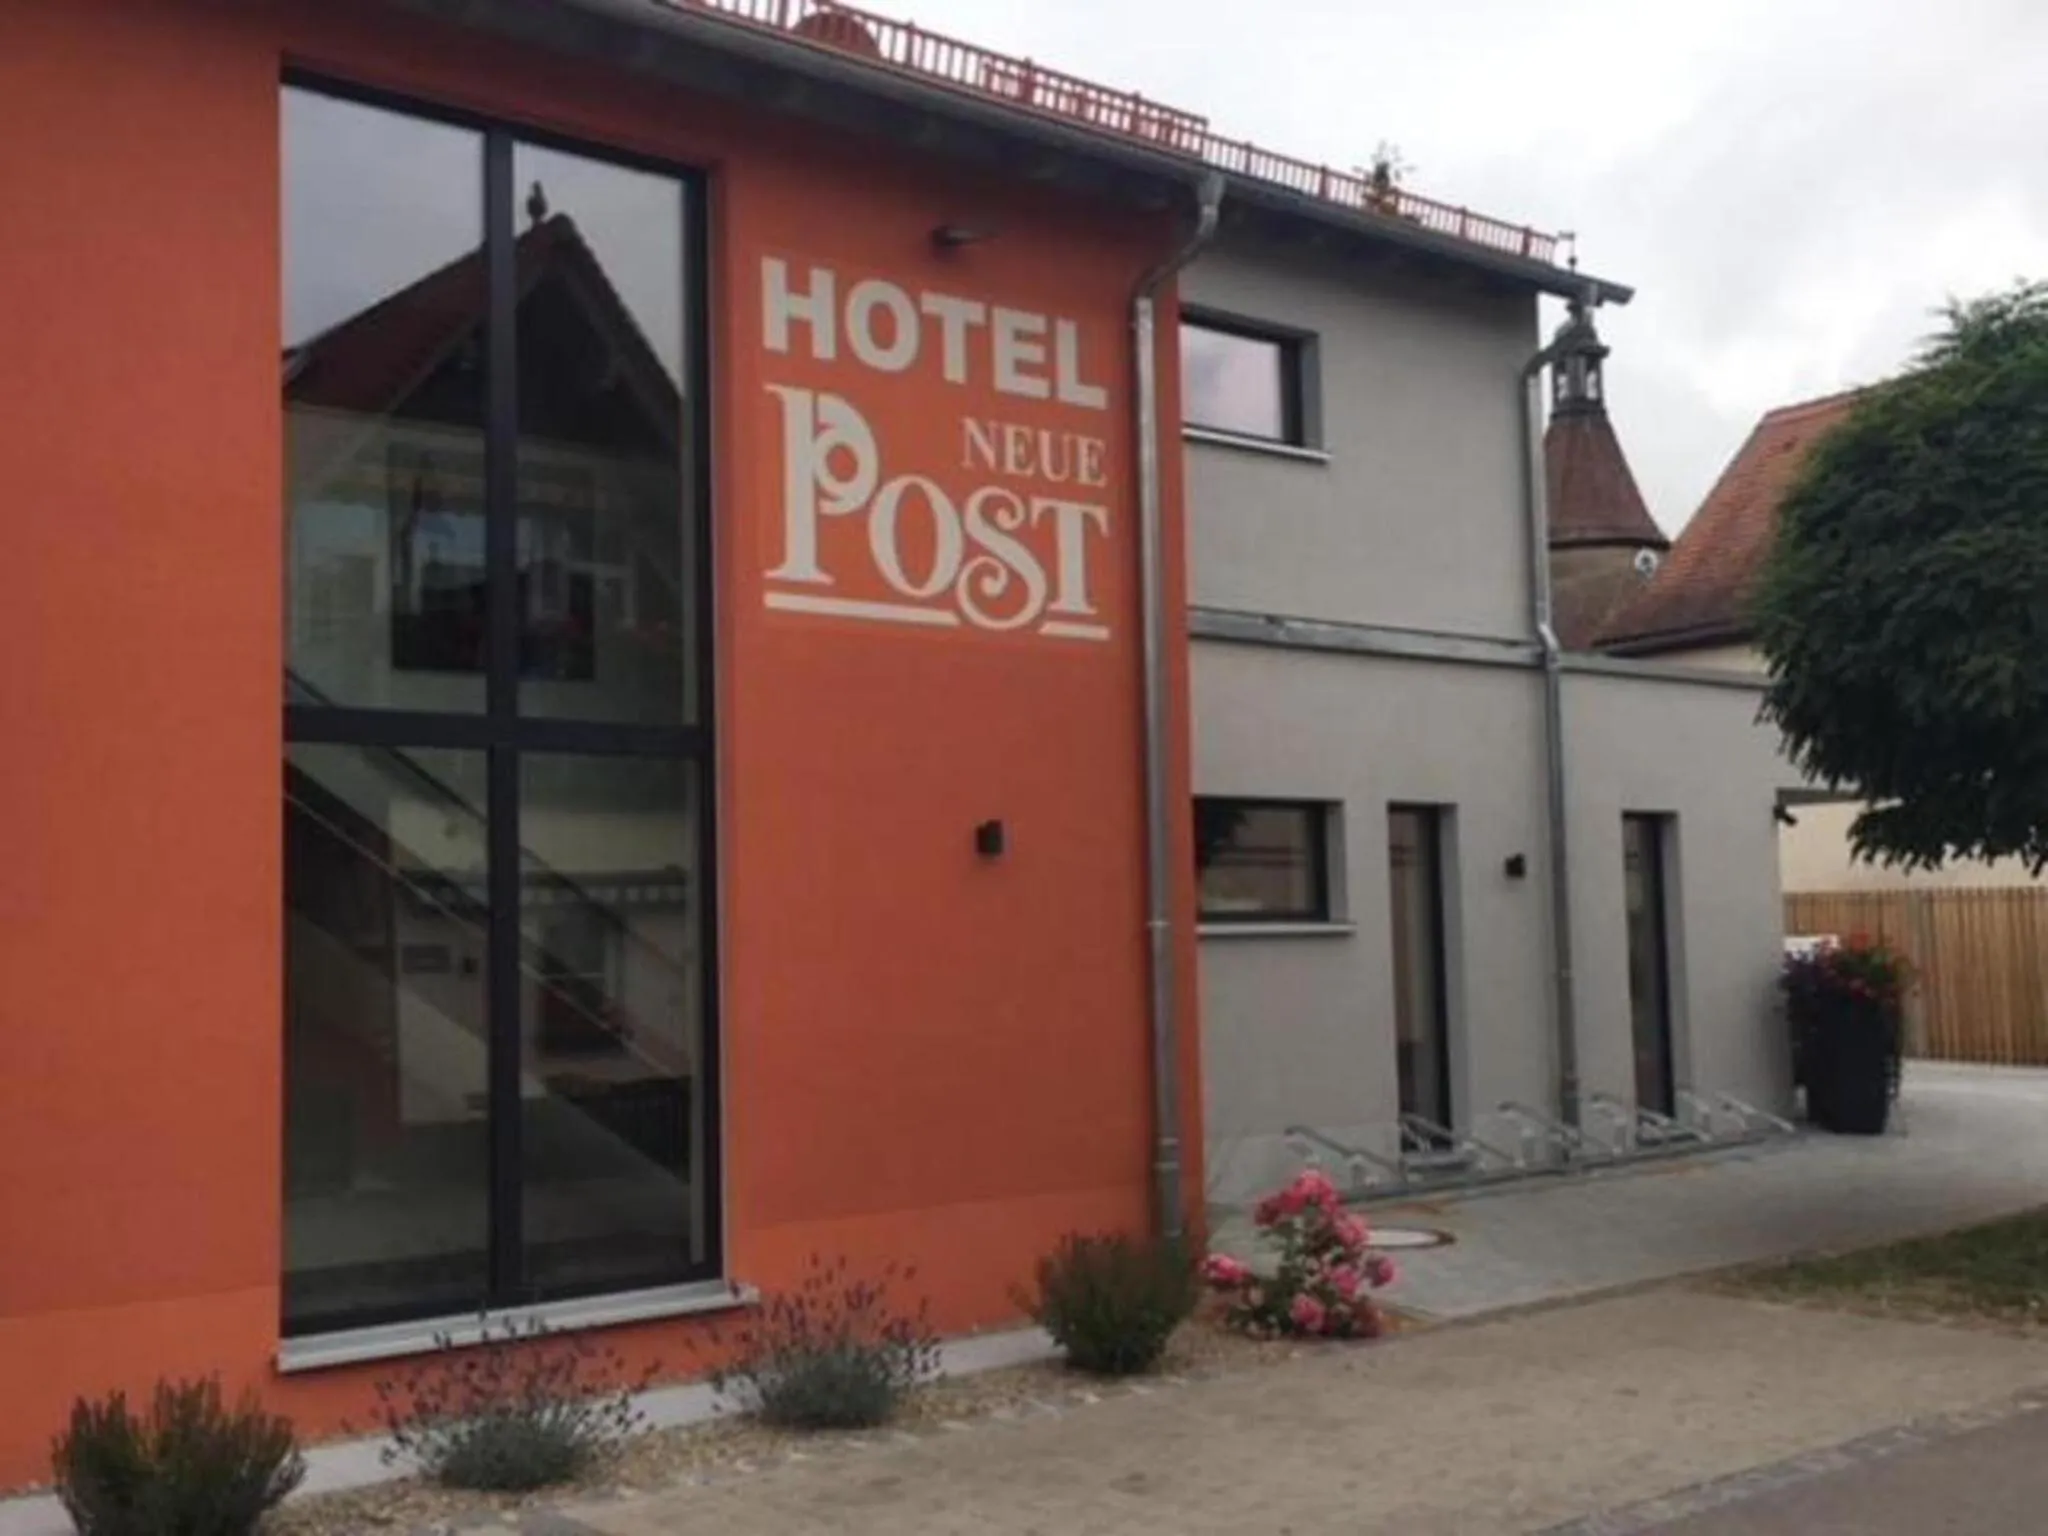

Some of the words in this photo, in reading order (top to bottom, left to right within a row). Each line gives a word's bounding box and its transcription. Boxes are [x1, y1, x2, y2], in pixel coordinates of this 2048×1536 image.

[761, 256, 1107, 410] HOTEL
[762, 382, 1109, 631] POST
[962, 417, 1108, 488] NEUE
